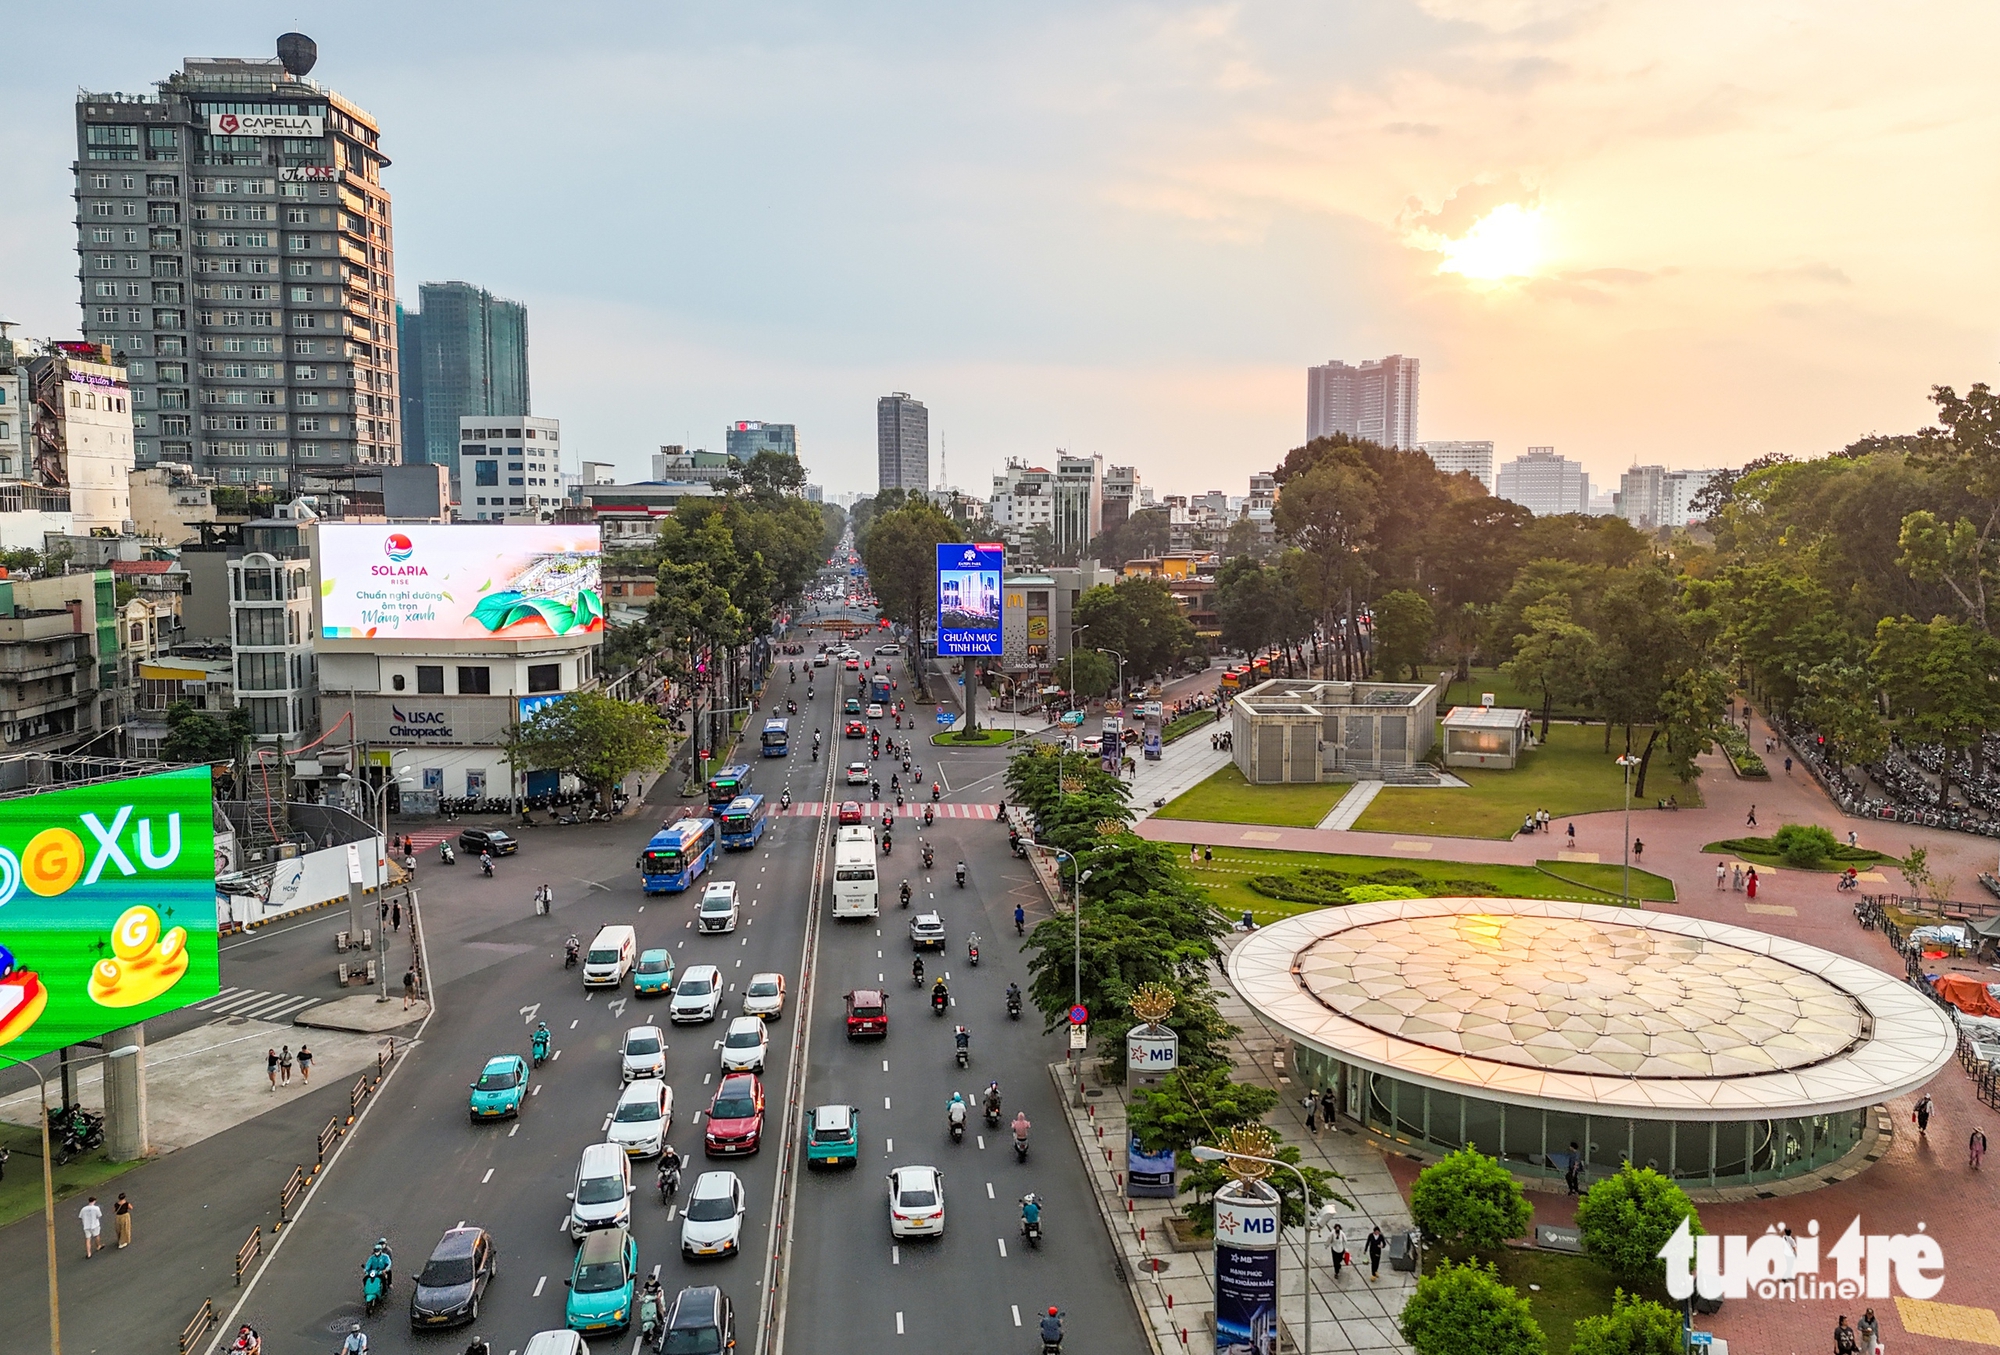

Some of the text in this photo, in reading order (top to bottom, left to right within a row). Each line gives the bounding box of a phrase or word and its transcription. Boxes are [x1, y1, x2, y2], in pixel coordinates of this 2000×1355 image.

[242, 118, 312, 129] CAPELLA
[282, 160, 334, 181] The ONE
[86, 372, 109, 386] Garden
[371, 565, 429, 576] SOLARIA
[381, 602, 418, 612] ôm trọn
[405, 603, 435, 622] xanh
[949, 643, 991, 652] TINH HOA
[408, 712, 444, 724] USAC
[389, 726, 453, 739] Chiropractic
[1150, 1049, 1174, 1062] MB
[1243, 1218, 1275, 1233] MB
[1240, 1255, 1252, 1263] MB
